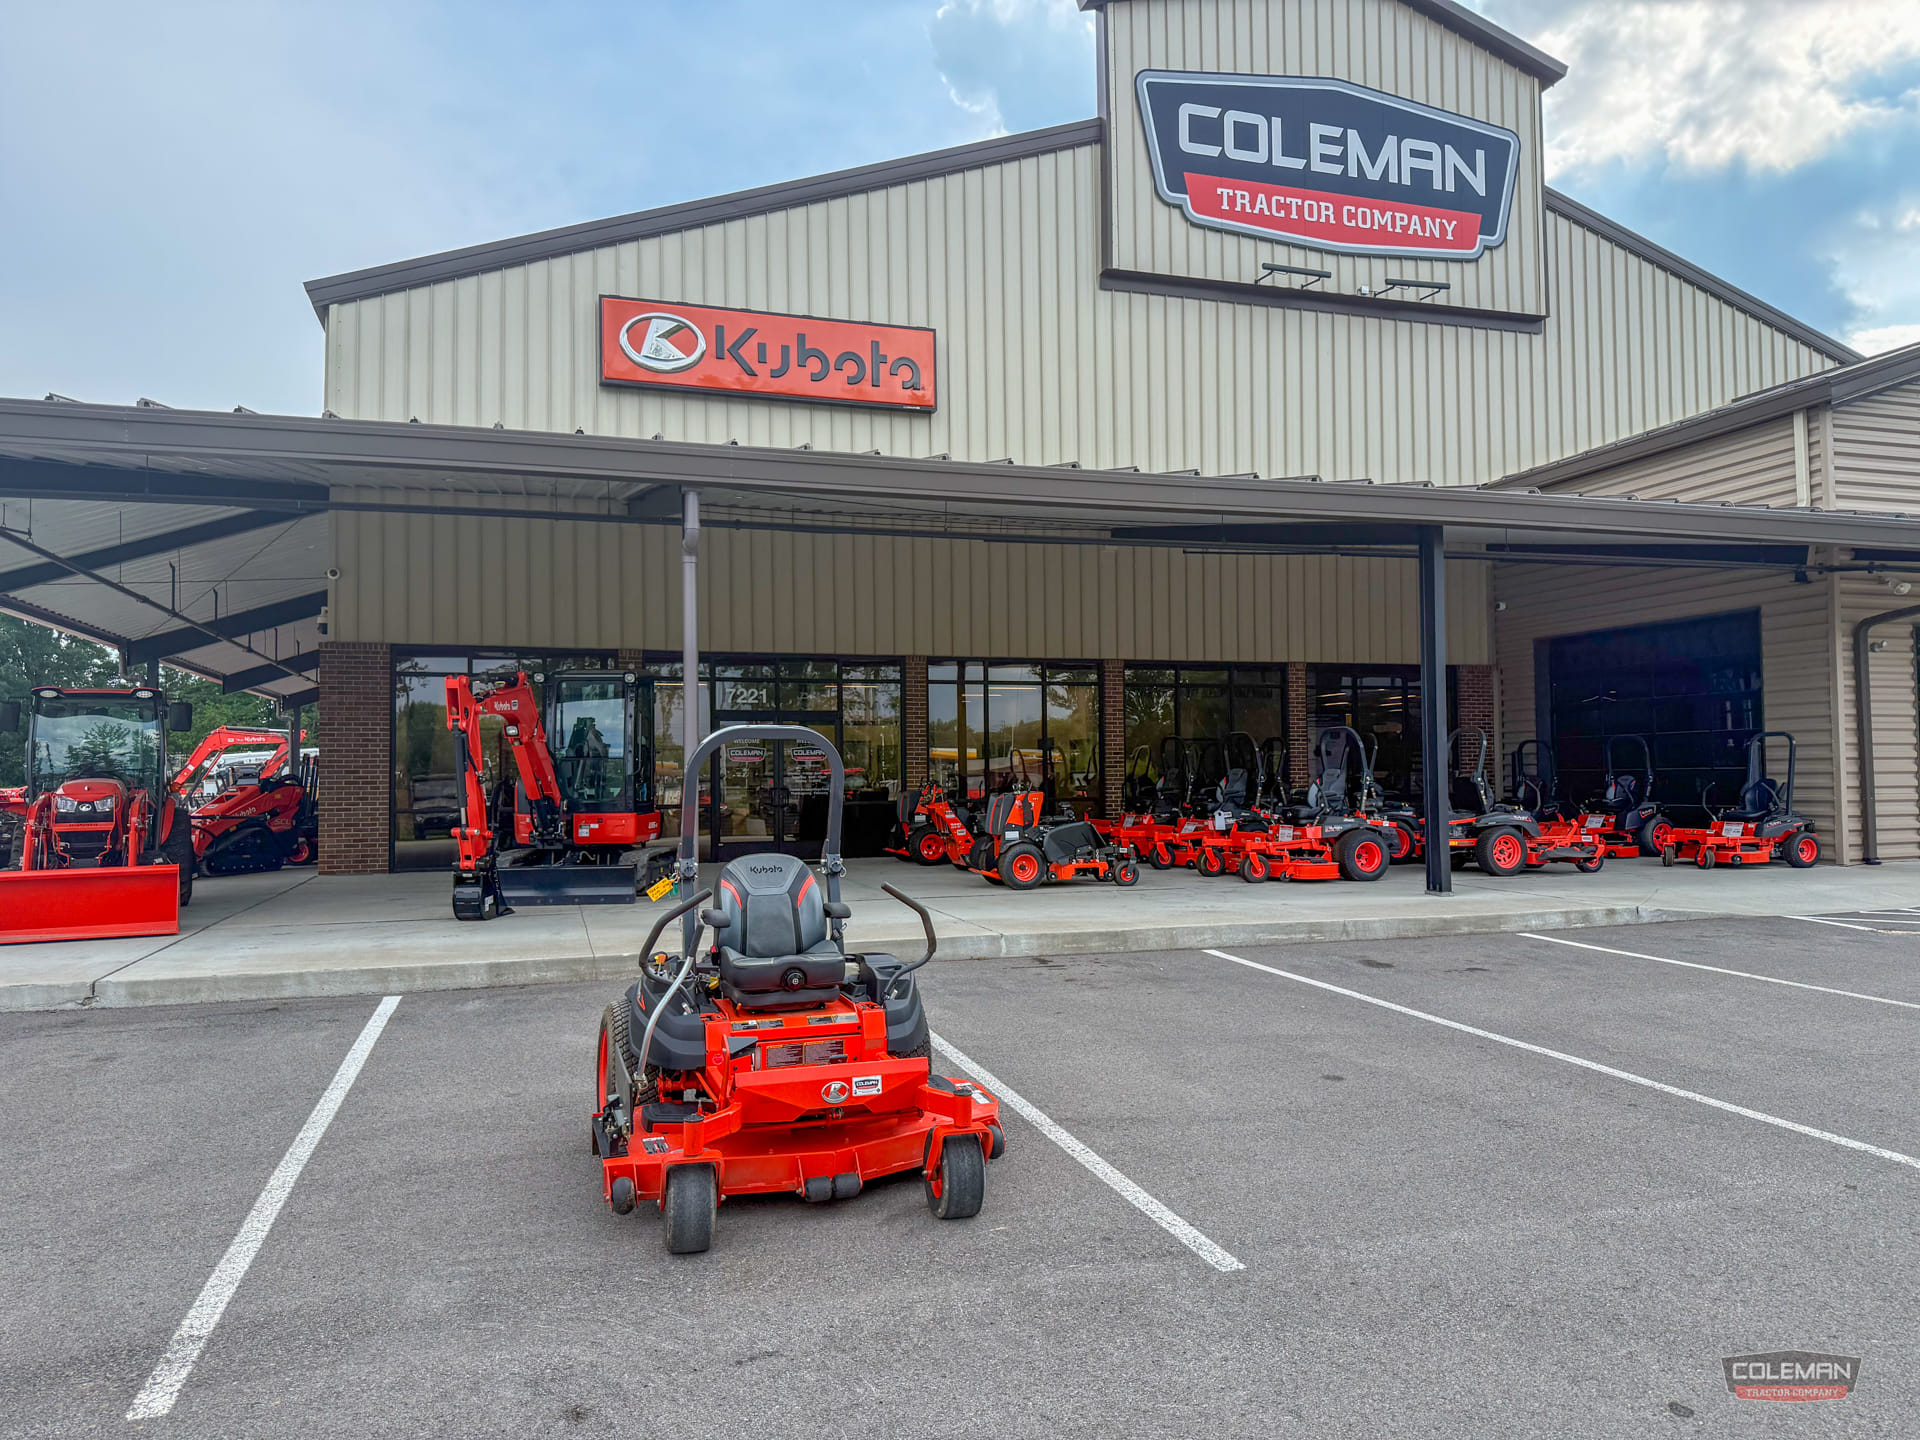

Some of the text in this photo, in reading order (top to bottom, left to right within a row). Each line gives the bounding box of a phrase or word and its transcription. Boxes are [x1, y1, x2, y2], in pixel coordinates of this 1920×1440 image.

[1178, 102, 1487, 197] COLEMAN
[1216, 187, 1458, 241] TRACTOR COMPANY
[714, 324, 921, 391] Kubota
[726, 688, 767, 704] 7221
[749, 865, 783, 874] Kubota
